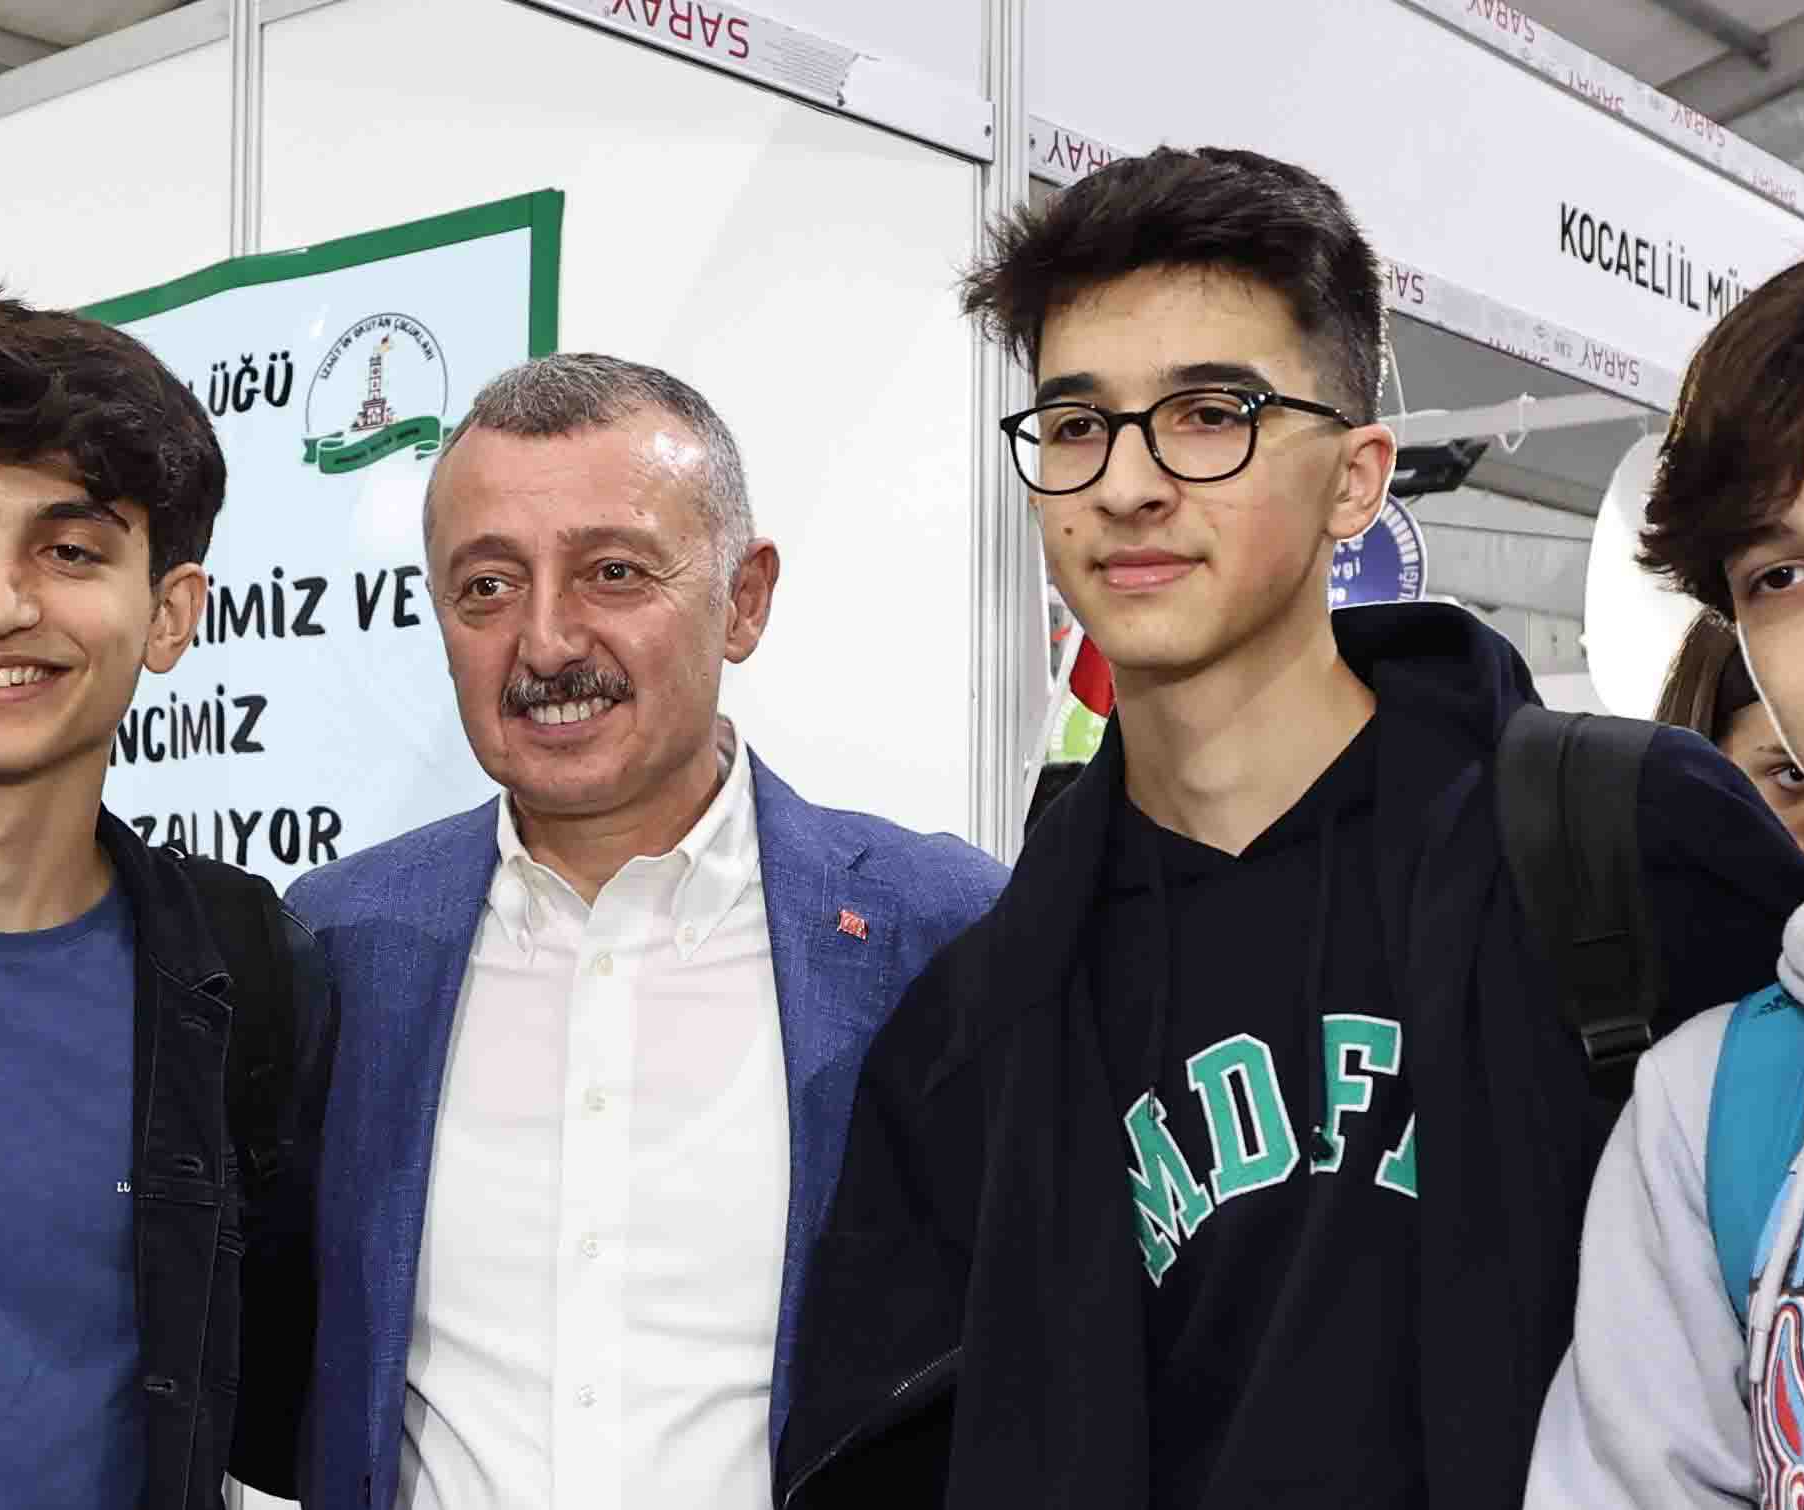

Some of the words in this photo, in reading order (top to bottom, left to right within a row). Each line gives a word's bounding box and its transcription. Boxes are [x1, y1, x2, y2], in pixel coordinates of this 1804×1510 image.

[1560, 201, 1673, 300] KOCAELİ
[1679, 244, 1701, 313] İL
[1707, 263, 1753, 320] MÜ
[189, 350, 294, 417] ÜĞÜ
[1580, 339, 1641, 387] SARAY
[193, 565, 328, 647] İMİZ
[355, 564, 423, 632] VE
